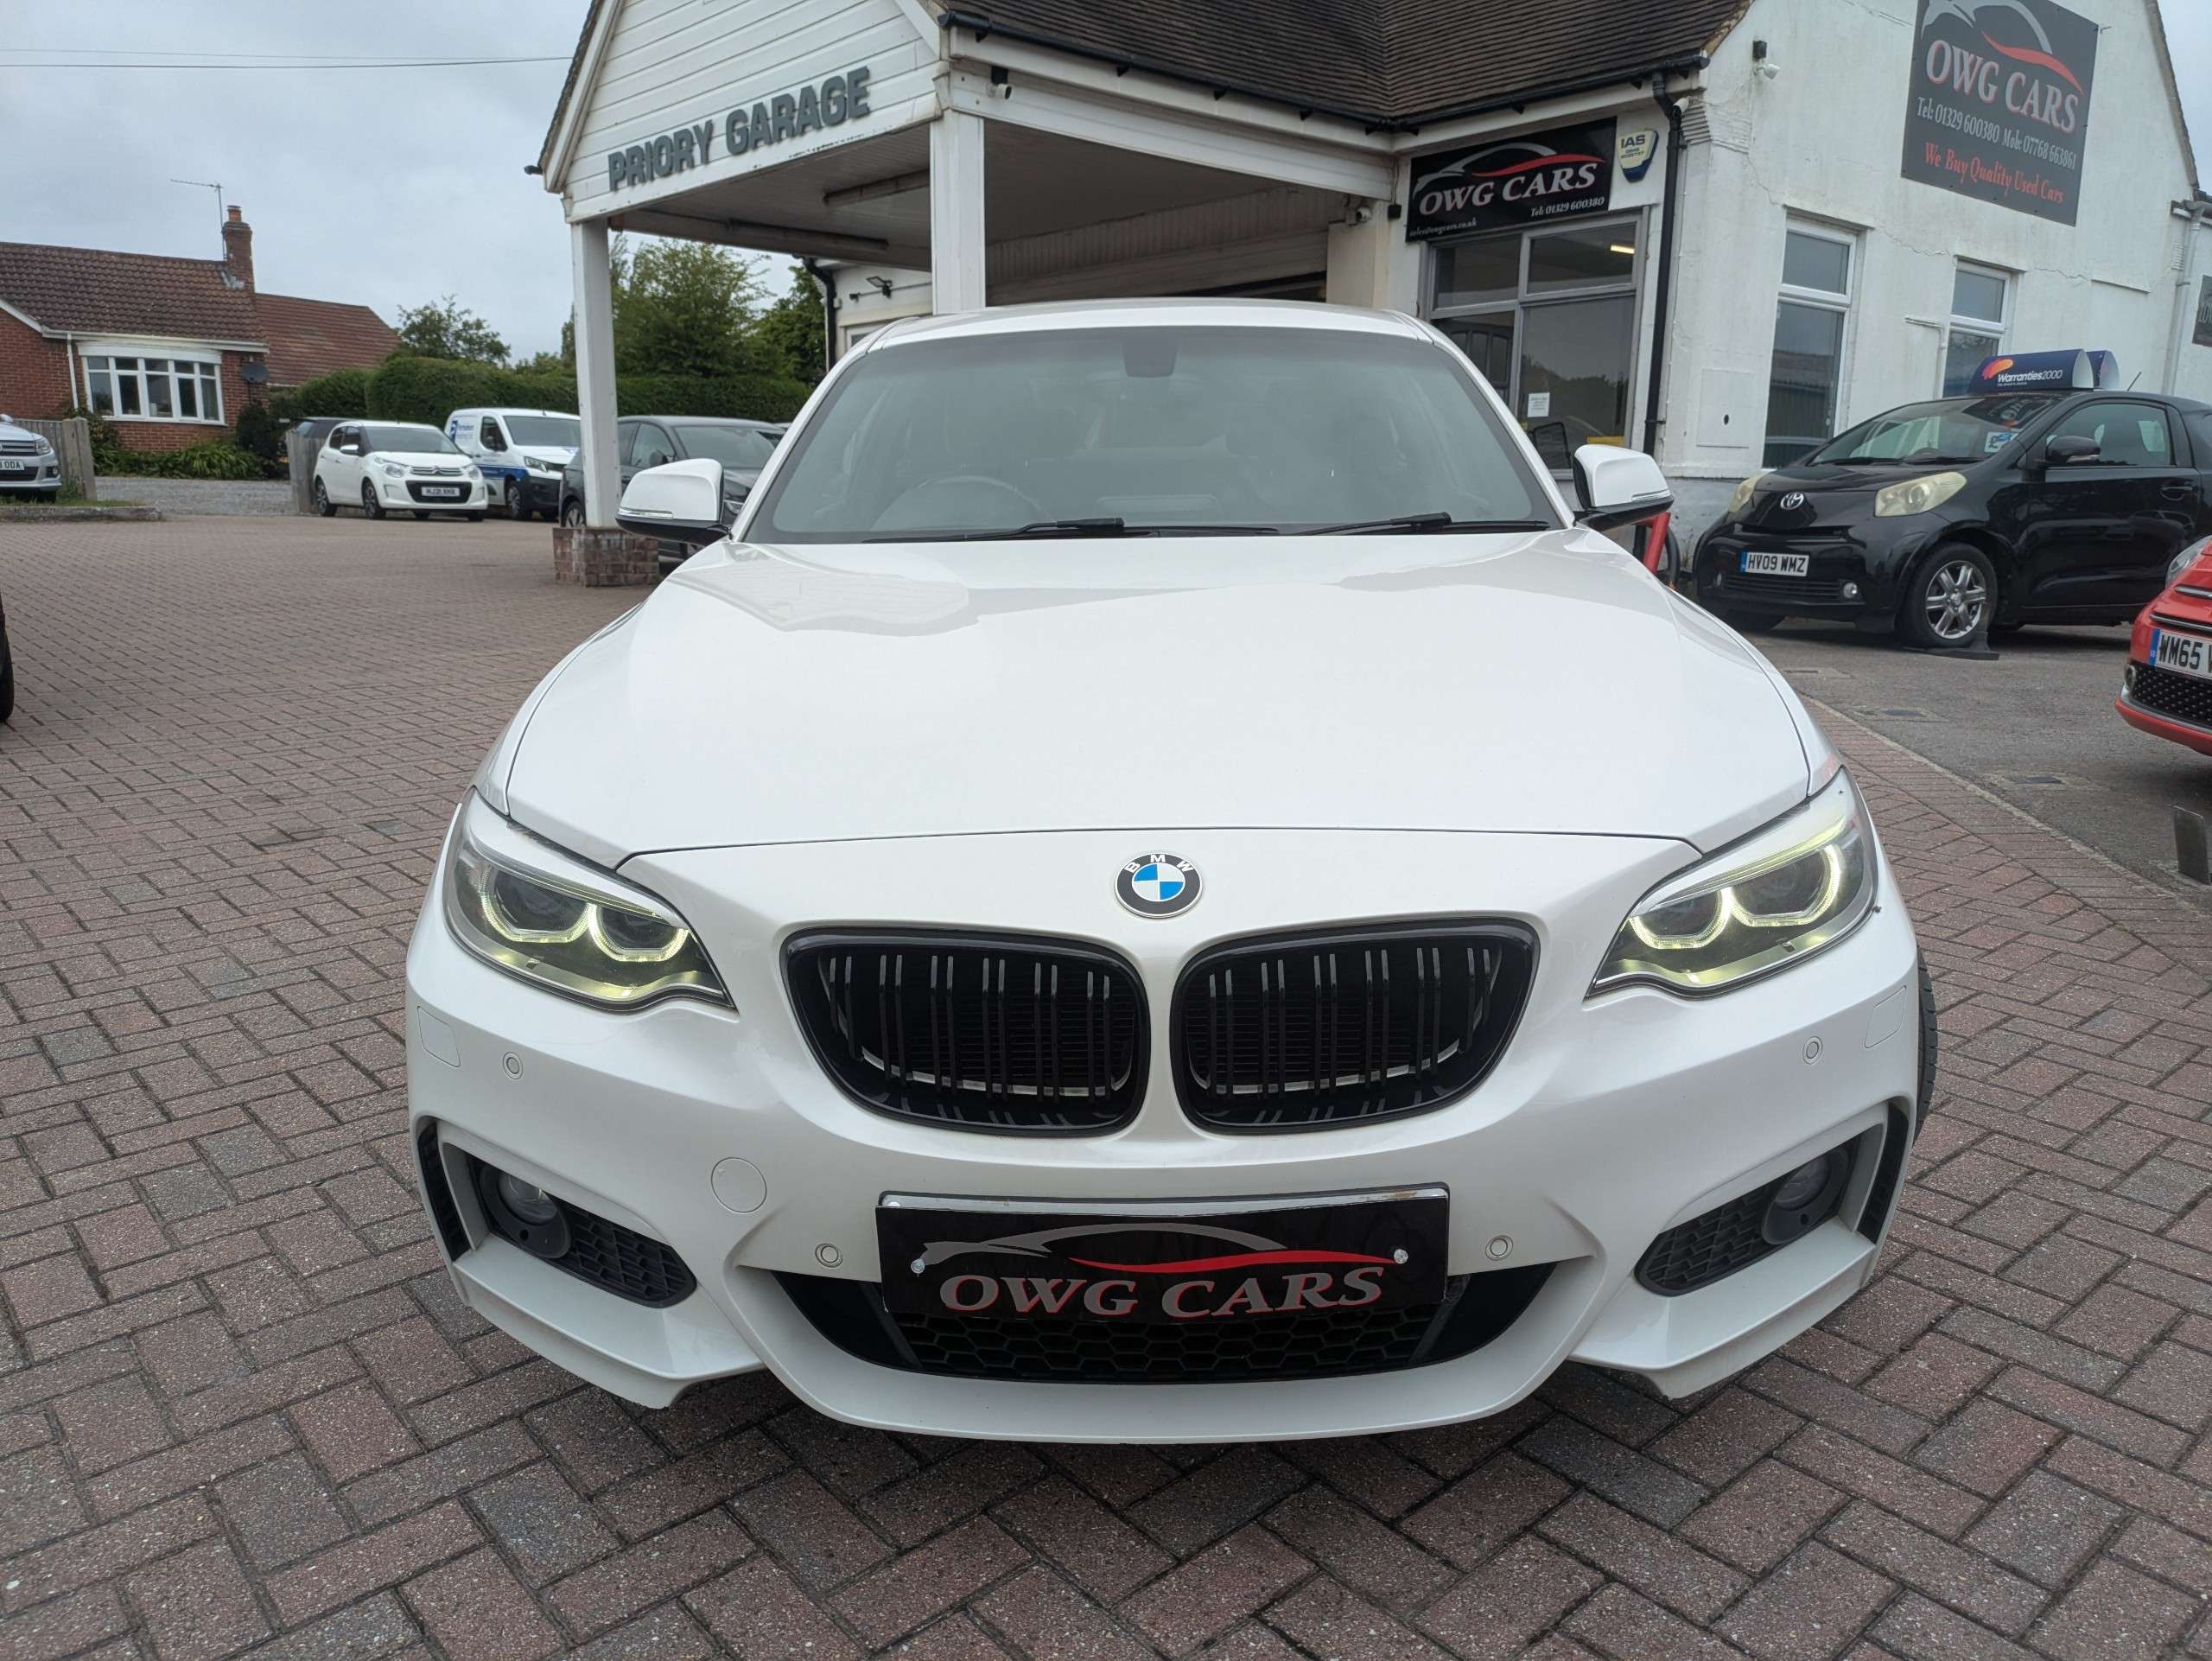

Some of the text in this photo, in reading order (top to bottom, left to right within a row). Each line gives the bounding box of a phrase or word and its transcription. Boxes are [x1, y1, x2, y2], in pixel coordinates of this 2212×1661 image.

[1926, 40, 2079, 135] OWG CARS
[607, 66, 871, 192] PRIORY GARAGE
[1621, 134, 1646, 149] IAS
[1916, 96, 2077, 170] Tel: 01329 600380 Mob: 07768 663861
[1419, 162, 1598, 215] OWG CARS
[1924, 141, 2065, 204] We Buy Quality Used Cars
[1545, 202, 1569, 213] 01329
[1571, 196, 1605, 211] 600380
[1998, 369, 2063, 384] Warranties2000
[1748, 554, 1807, 573] HV09 WMZ
[2159, 634, 2203, 671] WM65
[1124, 854, 1195, 874] BMW
[939, 1266, 1385, 1319] OWG CARS
